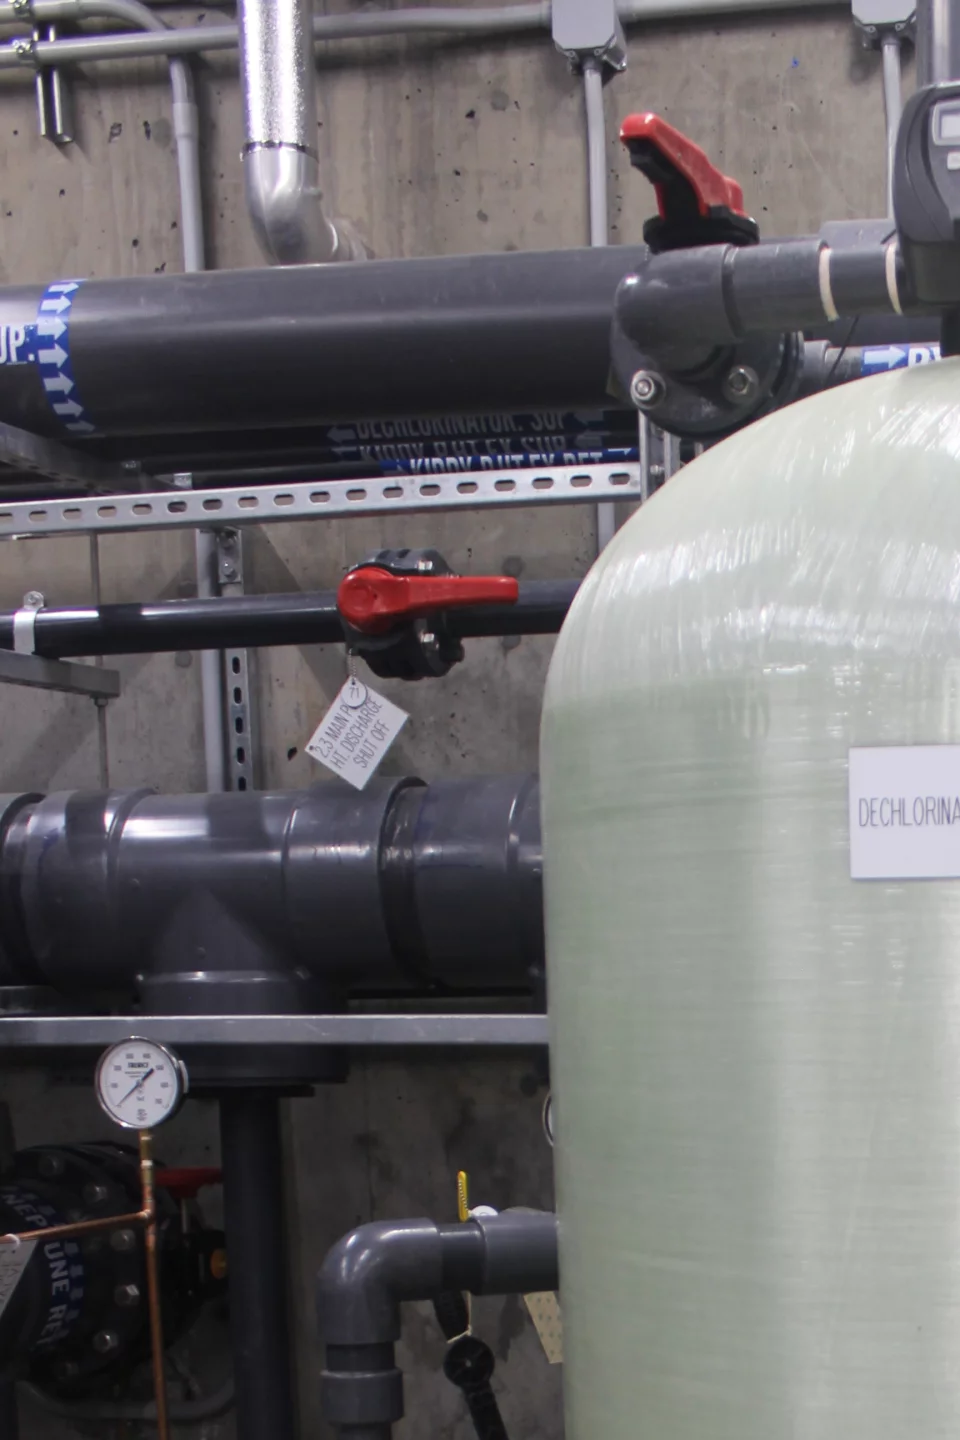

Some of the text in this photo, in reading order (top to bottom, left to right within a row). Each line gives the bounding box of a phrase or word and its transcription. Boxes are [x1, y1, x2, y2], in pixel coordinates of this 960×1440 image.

[324, 712, 351, 742] MAIN
[340, 696, 383, 754] DISCHARGE
[352, 719, 391, 769] SHUT OFF
[2, 1192, 71, 1297] NEPUNE
